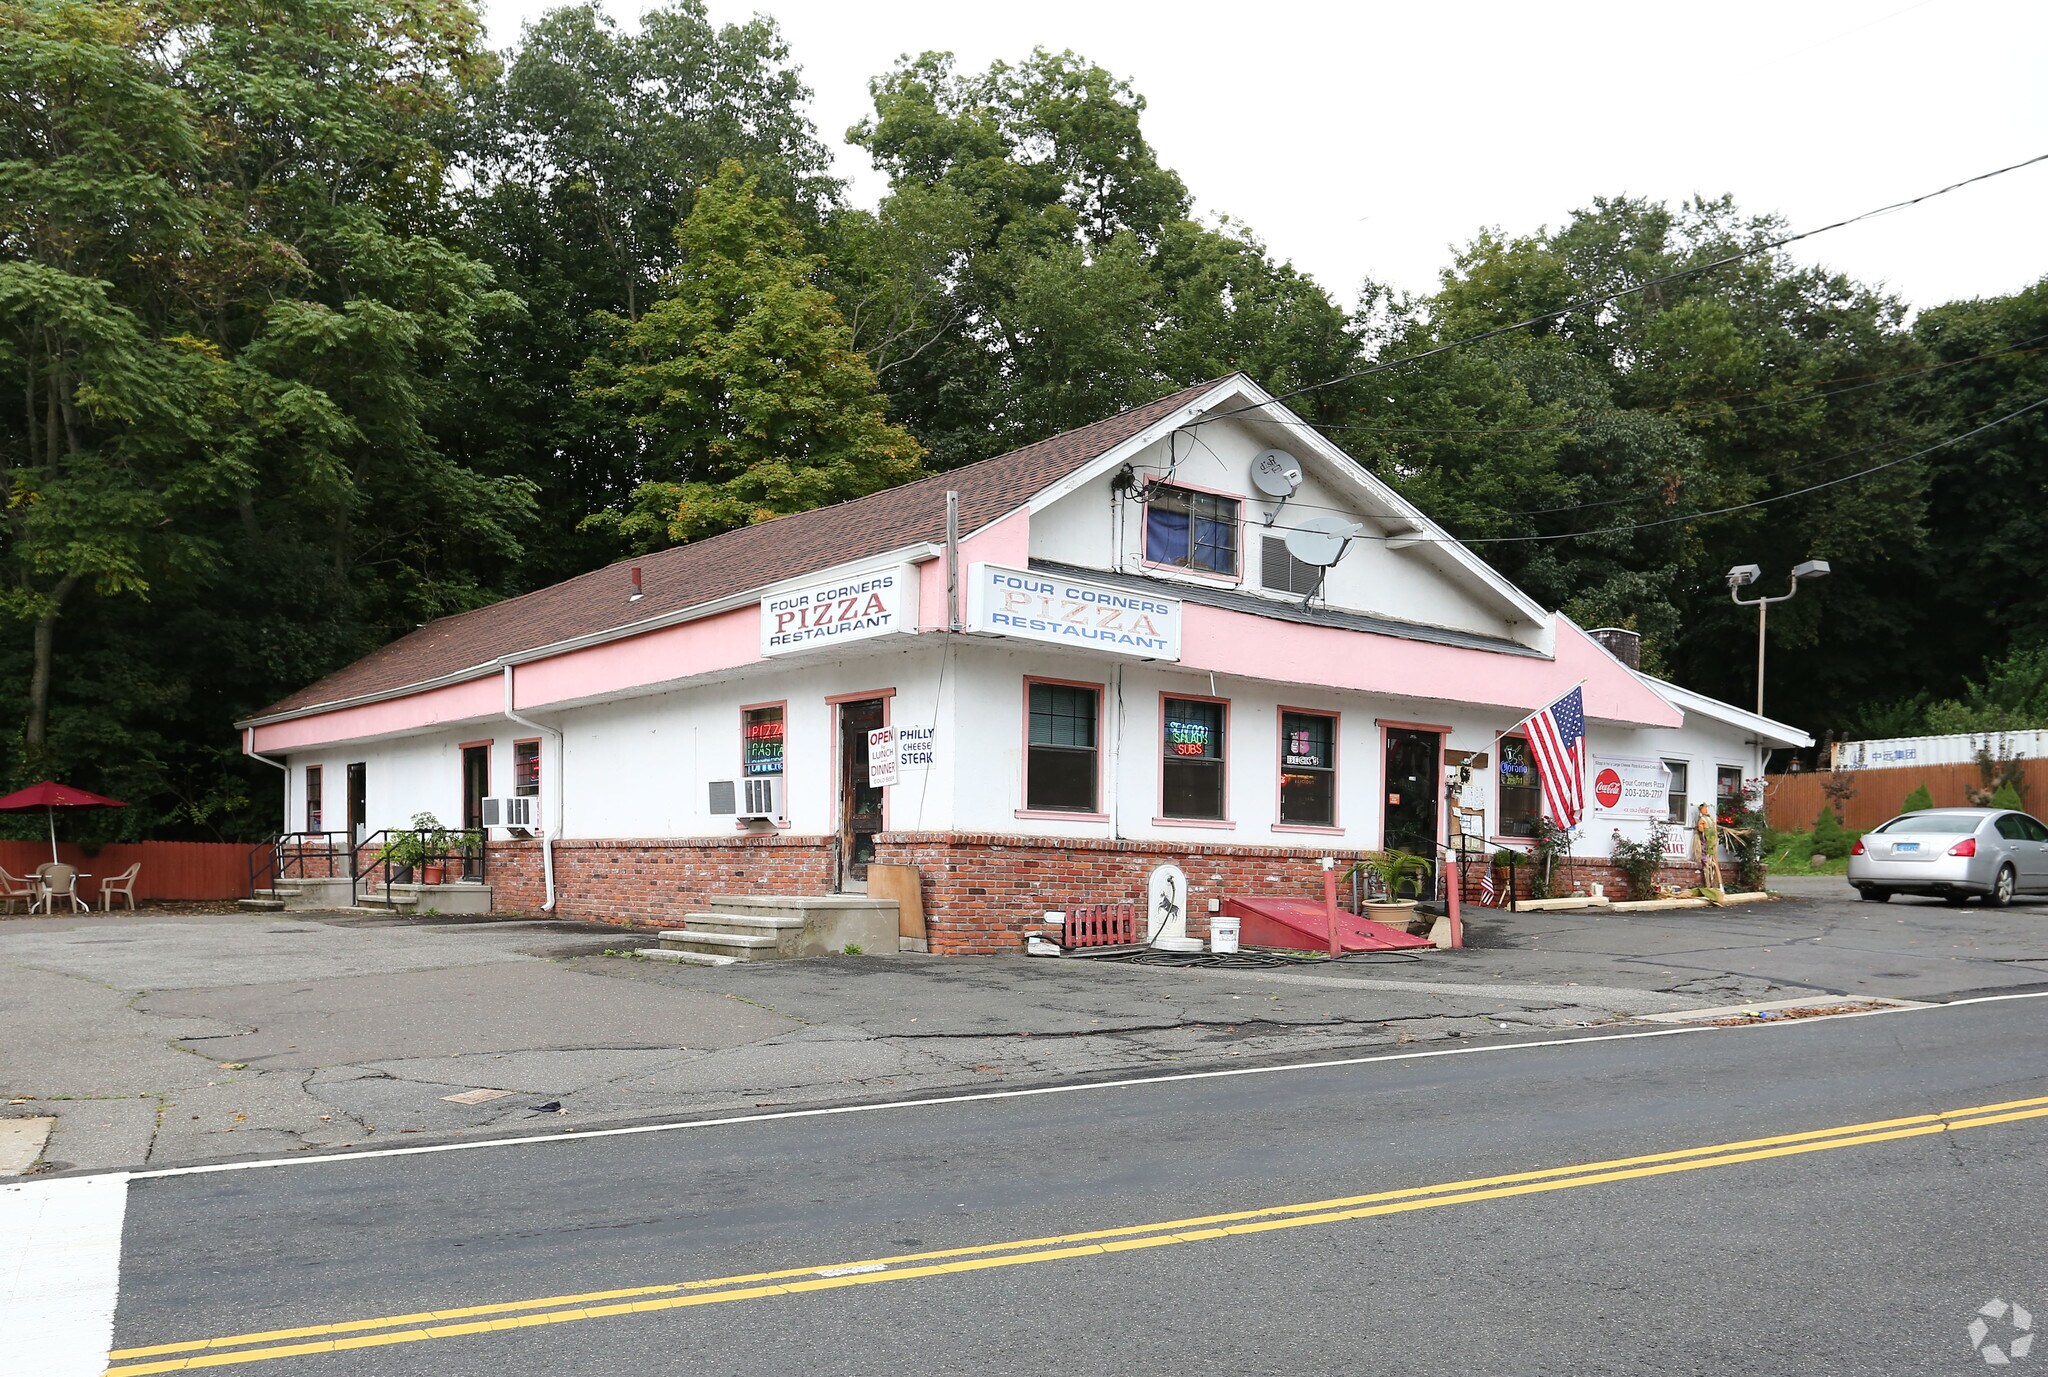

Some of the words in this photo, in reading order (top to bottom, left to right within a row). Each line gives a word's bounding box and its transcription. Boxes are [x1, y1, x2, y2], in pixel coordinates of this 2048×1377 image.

[770, 595, 809, 613] FOUR
[816, 576, 893, 603] CORNERS
[993, 574, 1055, 595] FOUR
[1065, 588, 1169, 615] CORNERS
[775, 592, 887, 634] PIZZA
[999, 588, 1161, 637] PIZZA
[770, 613, 892, 646] RESTAURANT
[992, 613, 1168, 650] RESTAURANT
[751, 723, 783, 740] PIZZA
[900, 728, 934, 740] PHILLY
[1170, 721, 1208, 736] SEAFOOD
[870, 730, 893, 746] OPEN
[1173, 733, 1208, 745] SALADS
[751, 742, 783, 756] PASTA
[903, 741, 931, 751] CHEESE
[1178, 744, 1202, 755] SUBS
[872, 748, 894, 760] LUNCH
[901, 752, 933, 765] STEAK
[1872, 749, 1916, 761] 中远集团
[871, 761, 896, 777] DINNER
[1500, 760, 1529, 775] Corona
[1596, 781, 1620, 795] Coca-Cola
[1623, 778, 1633, 786] Four
[1634, 779, 1653, 787] Corners
[1654, 780, 1665, 788] Pizza
[1625, 788, 1663, 798] 203-238-2717
